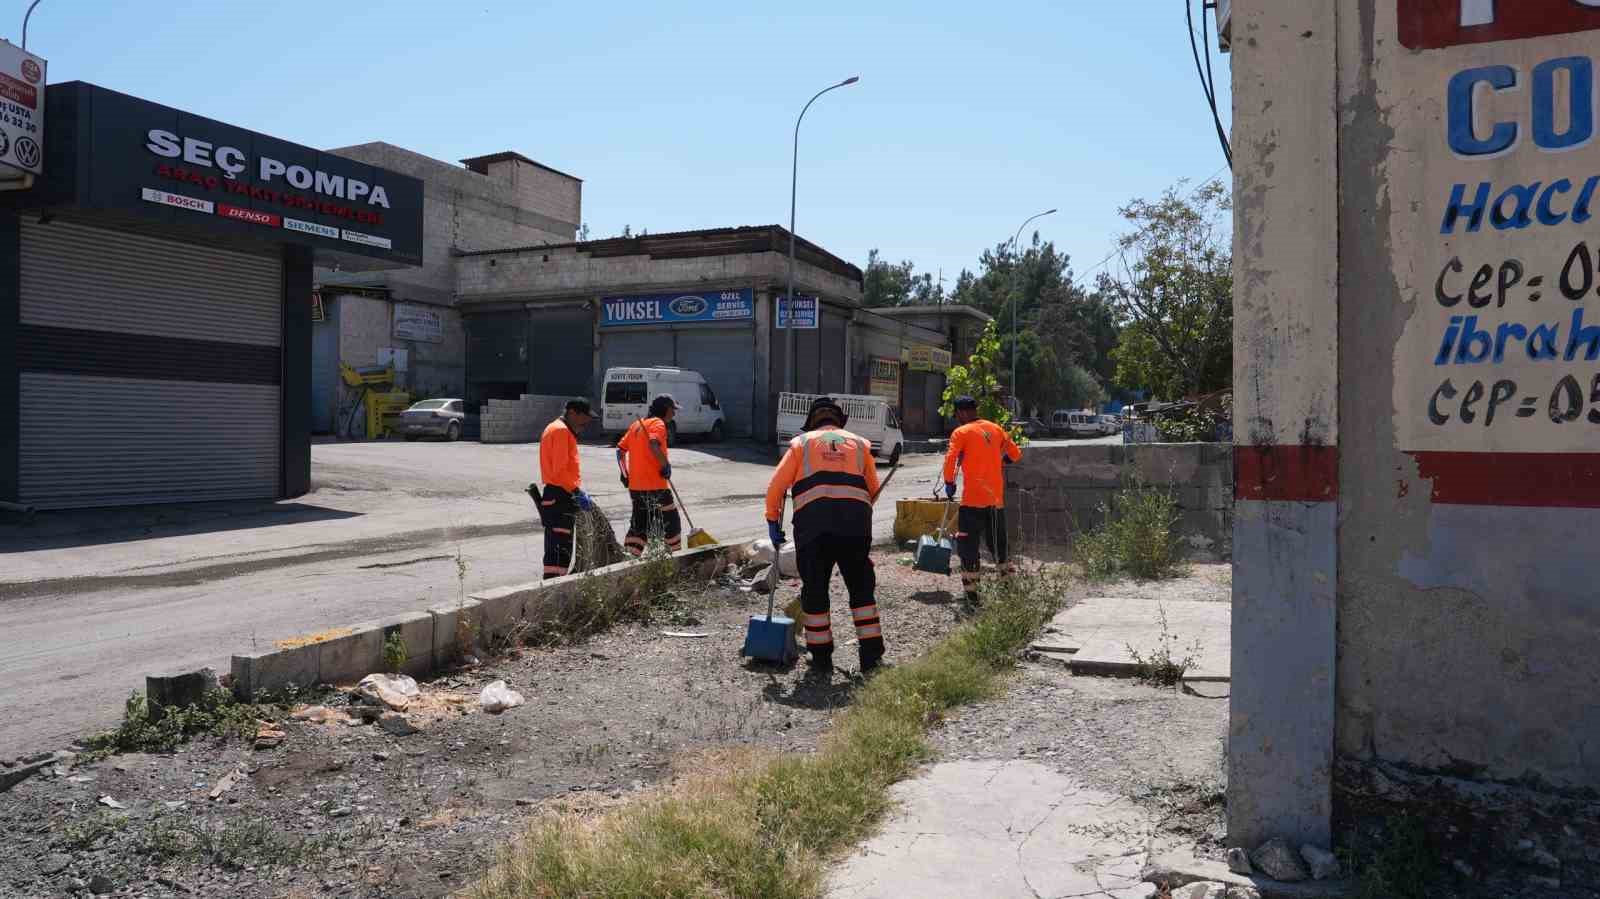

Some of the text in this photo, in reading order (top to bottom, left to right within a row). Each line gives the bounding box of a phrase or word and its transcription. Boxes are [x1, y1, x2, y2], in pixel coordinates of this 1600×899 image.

[9, 103, 31, 118] USTA
[145, 129, 391, 209] SEÇ POMPA
[167, 194, 205, 210] BOSCH
[228, 207, 271, 224] DENSO
[287, 220, 337, 236] SIEMENS
[606, 298, 663, 321] YÜKSEL
